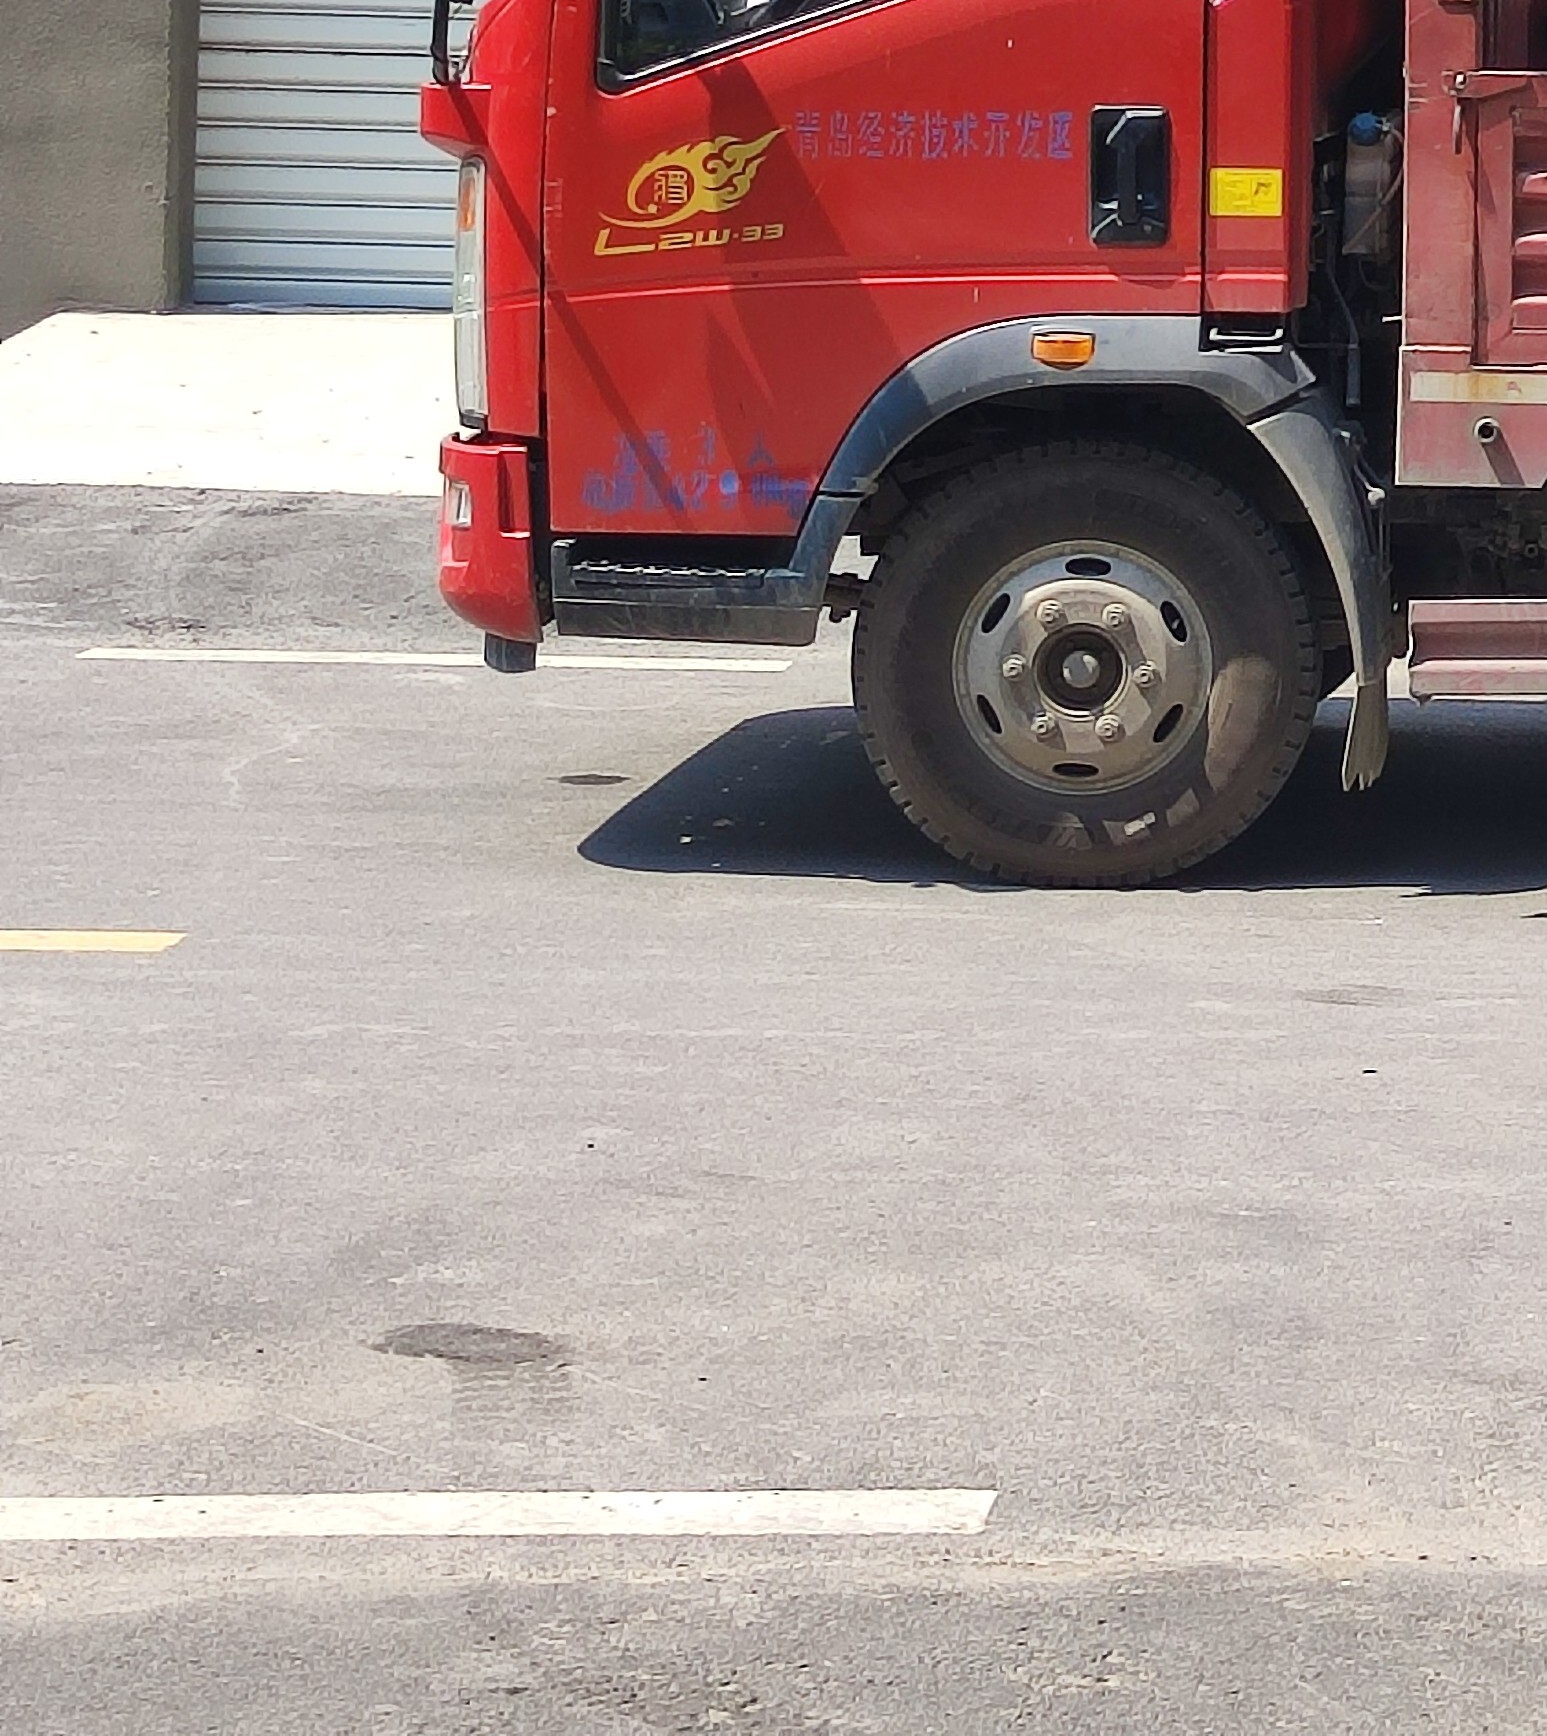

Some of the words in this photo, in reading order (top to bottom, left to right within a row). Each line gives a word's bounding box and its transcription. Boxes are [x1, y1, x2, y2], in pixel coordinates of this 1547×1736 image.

[795, 110, 1073, 160] 青岛经济技术开发区
